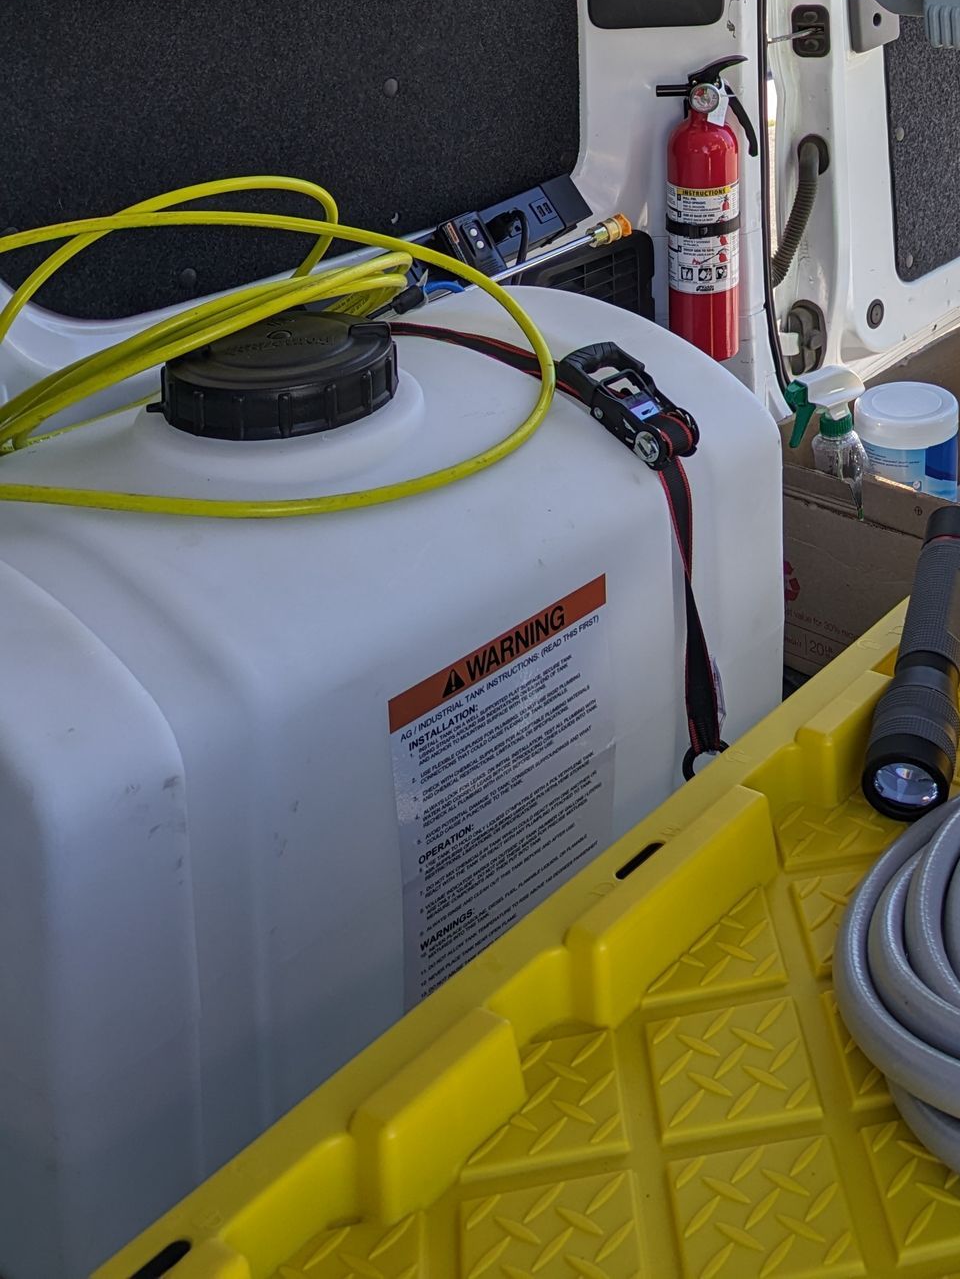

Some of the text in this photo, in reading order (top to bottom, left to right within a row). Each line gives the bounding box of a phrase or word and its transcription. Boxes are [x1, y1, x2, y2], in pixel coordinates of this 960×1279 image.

[682, 187, 726, 197] INSTRUCTIONS
[466, 602, 565, 683] WARNING
[400, 728, 412, 742] AG
[418, 697, 463, 731] INDUSTRIAL
[465, 683, 484, 703] TANK
[486, 650, 539, 690] INSTRUCTIONS:
[541, 636, 561, 656] (READ
[563, 626, 577, 643] THIS
[578, 613, 599, 633] FIRST)
[408, 701, 478, 751] INSTALLATION:
[418, 736, 438, 753] INSTALL
[440, 728, 452, 740] TANK
[454, 723, 460, 731] ON
[466, 712, 478, 723] WELL
[479, 693, 507, 715] SUPPORTED
[422, 780, 439, 796] CHECK
[440, 771, 453, 785] WITH
[454, 755, 478, 776] CHEMICAL
[479, 738, 504, 760] SUPPLIERS
[505, 732, 514, 743] FOR
[515, 713, 544, 736] ACCEPTABLE
[544, 699, 566, 717] PLUMBING
[483, 727, 493, 738] FOR
[420, 757, 456, 785] CONNECTIONS
[457, 749, 468, 761] THAT
[470, 738, 486, 753] COULD
[487, 727, 503, 742] CAUSE
[425, 824, 440, 840] AVOID
[441, 807, 467, 829] POTENTIAL
[468, 793, 488, 811] DAMAGE
[489, 788, 496, 797] TO
[426, 829, 443, 845] COULD
[444, 818, 461, 833] CAUSE
[466, 798, 491, 819] PUNCTURE
[493, 792, 499, 801] TO
[500, 786, 508, 797] THE
[418, 822, 473, 865] OPERATION:
[420, 906, 475, 951] WARNINGS:
